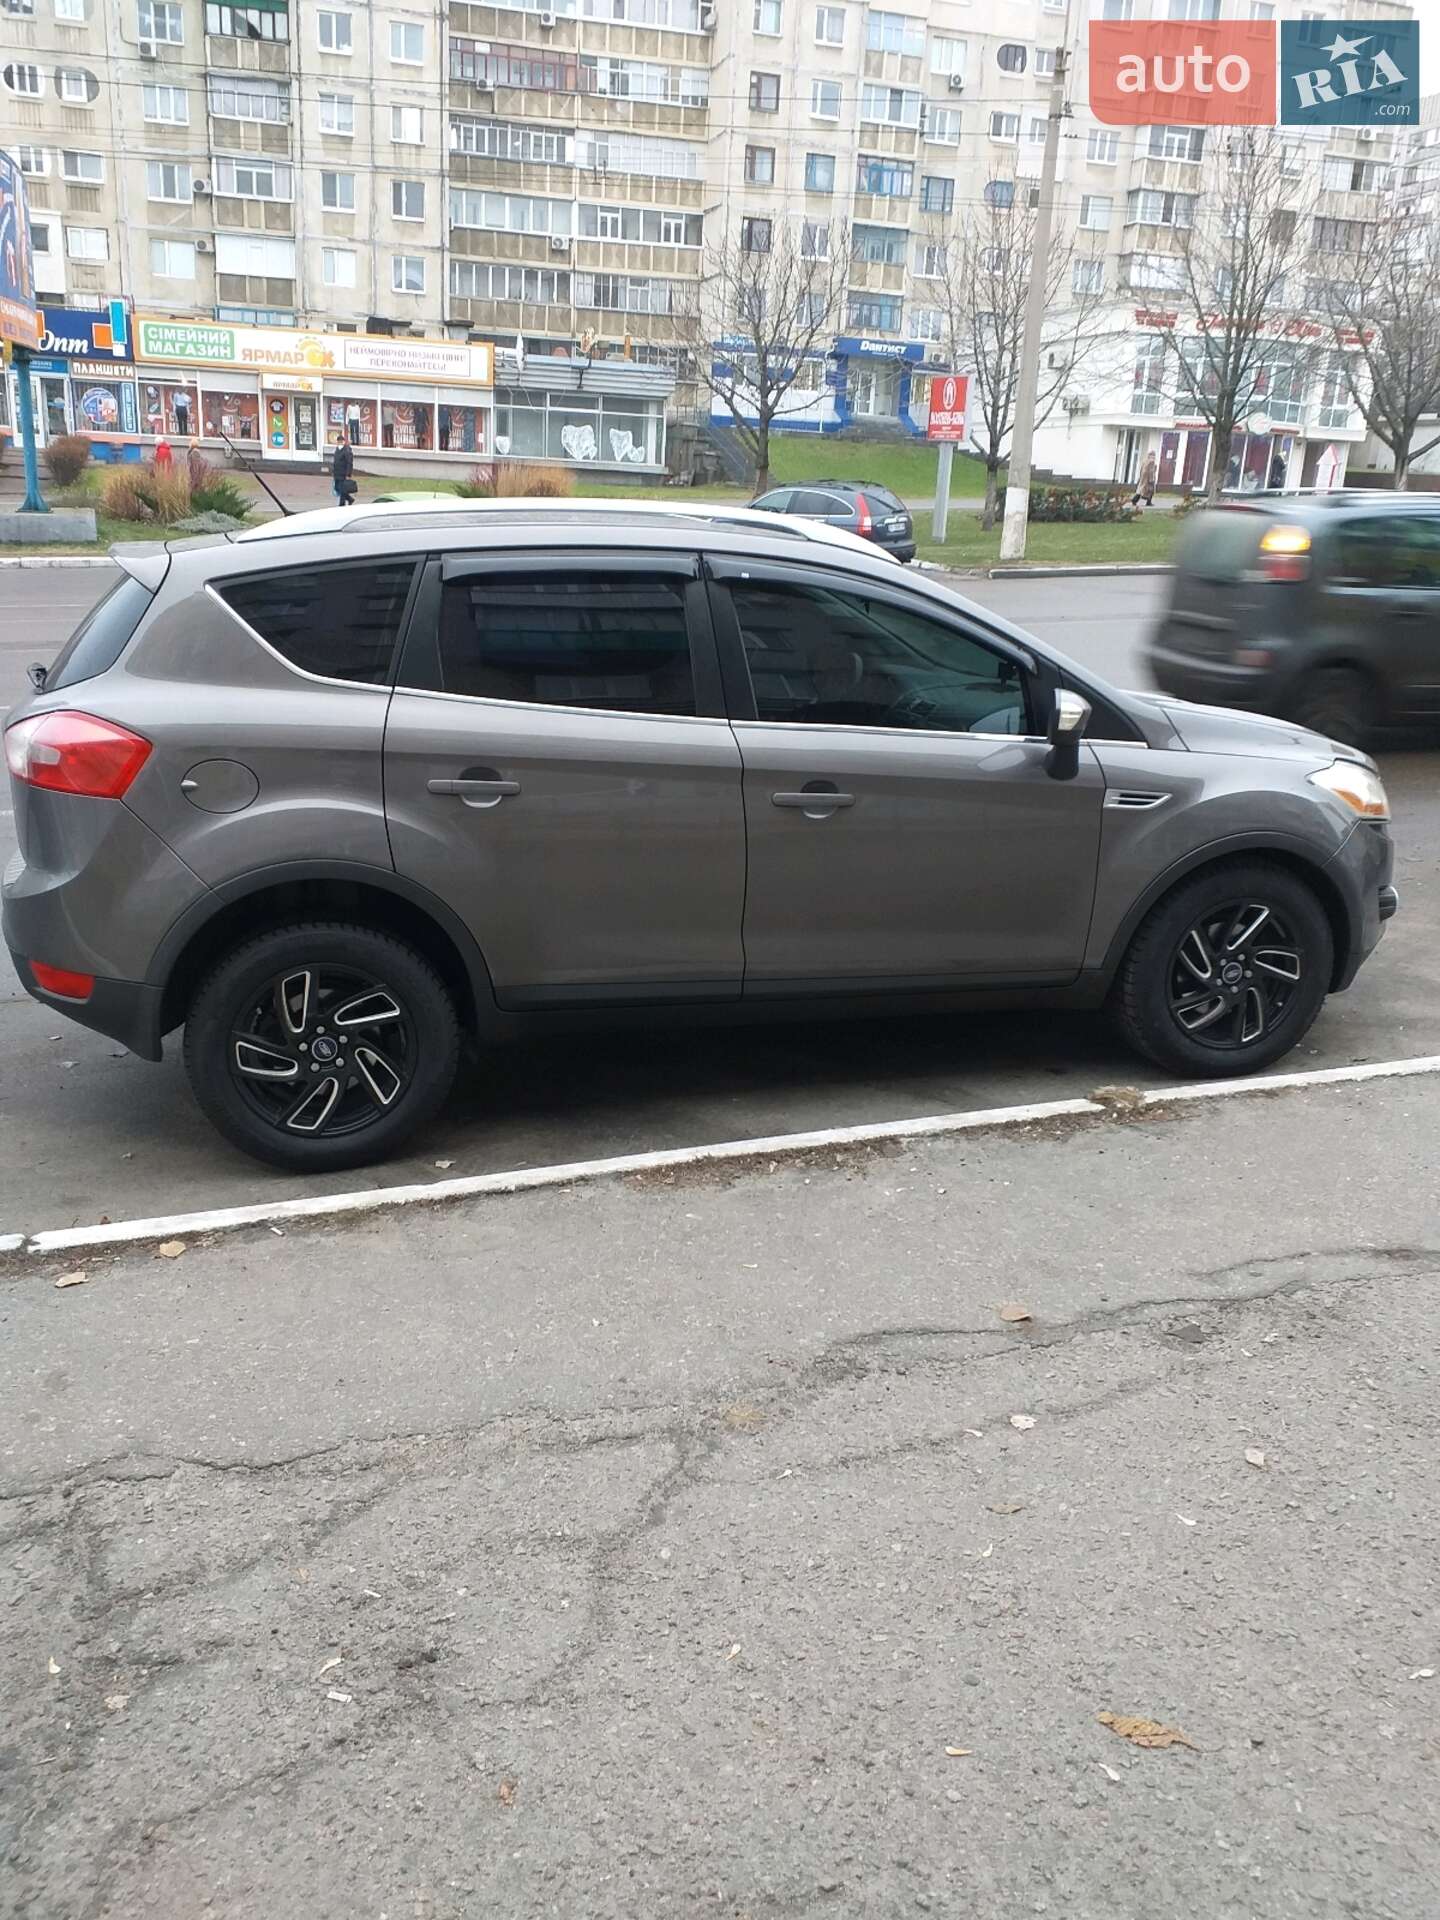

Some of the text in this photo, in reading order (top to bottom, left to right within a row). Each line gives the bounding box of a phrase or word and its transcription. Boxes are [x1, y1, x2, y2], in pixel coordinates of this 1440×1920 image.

[147, 327, 230, 345] СІМЕЙНИЙ
[149, 341, 231, 358] МАГАЗИН
[73, 362, 134, 377] ПЛАНШЕТИ
